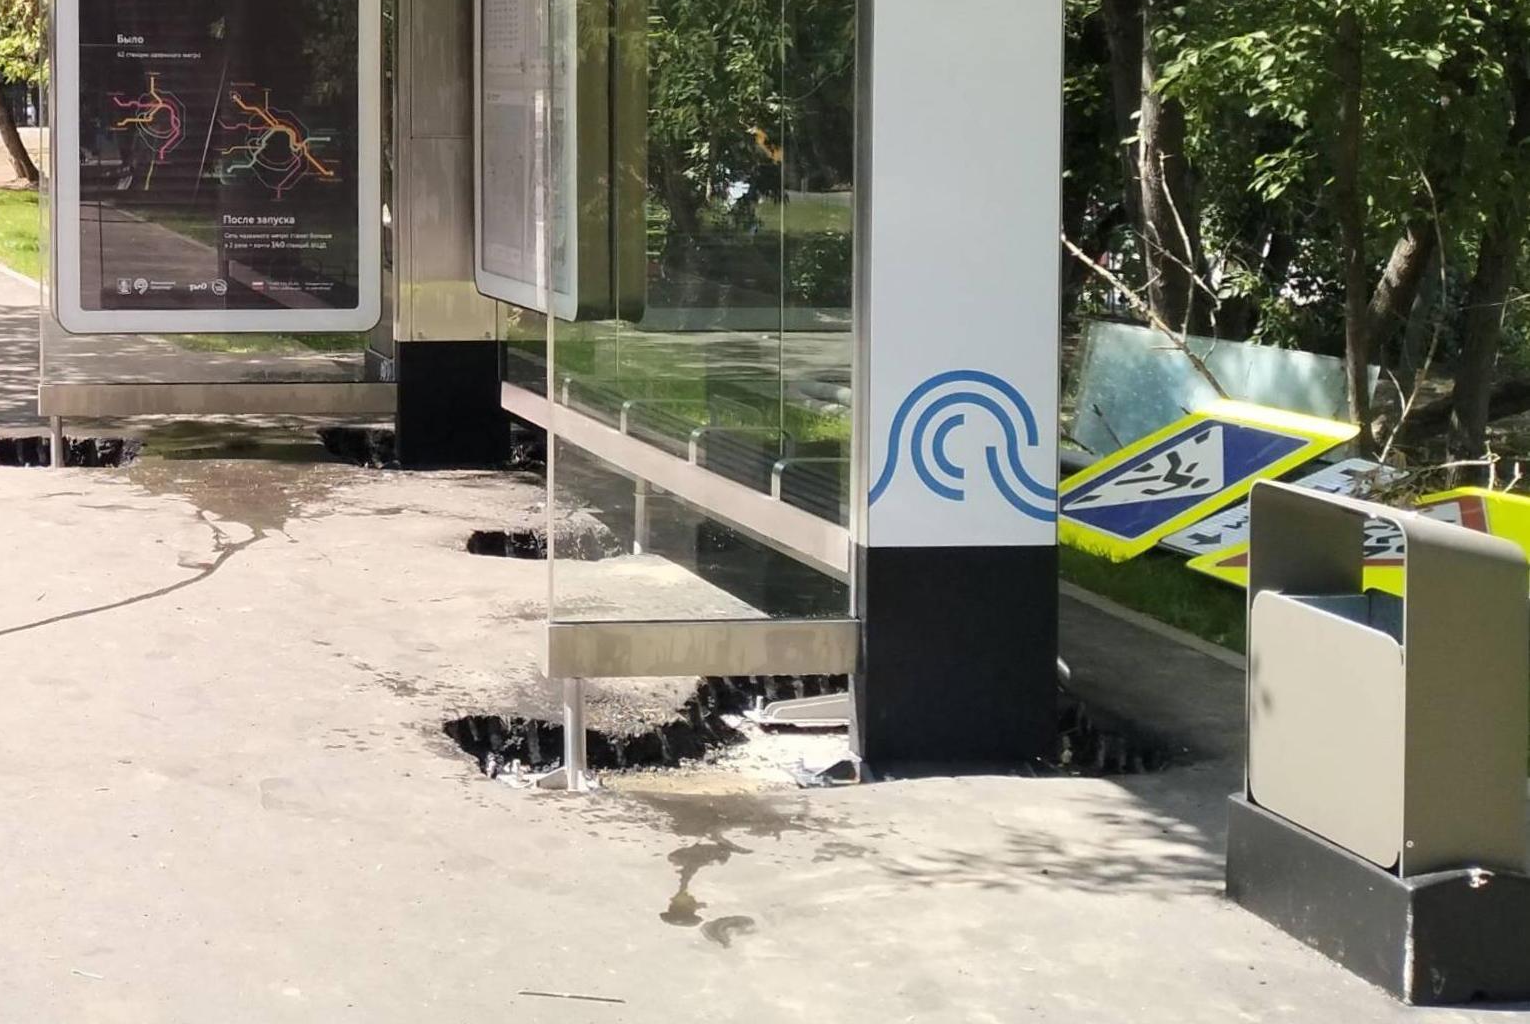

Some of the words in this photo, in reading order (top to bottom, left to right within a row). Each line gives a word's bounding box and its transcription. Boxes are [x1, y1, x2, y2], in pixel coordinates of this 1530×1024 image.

[116, 34, 145, 44] Было
[223, 215, 255, 225] После
[257, 217, 295, 226] запуска
[271, 241, 286, 249] 140
